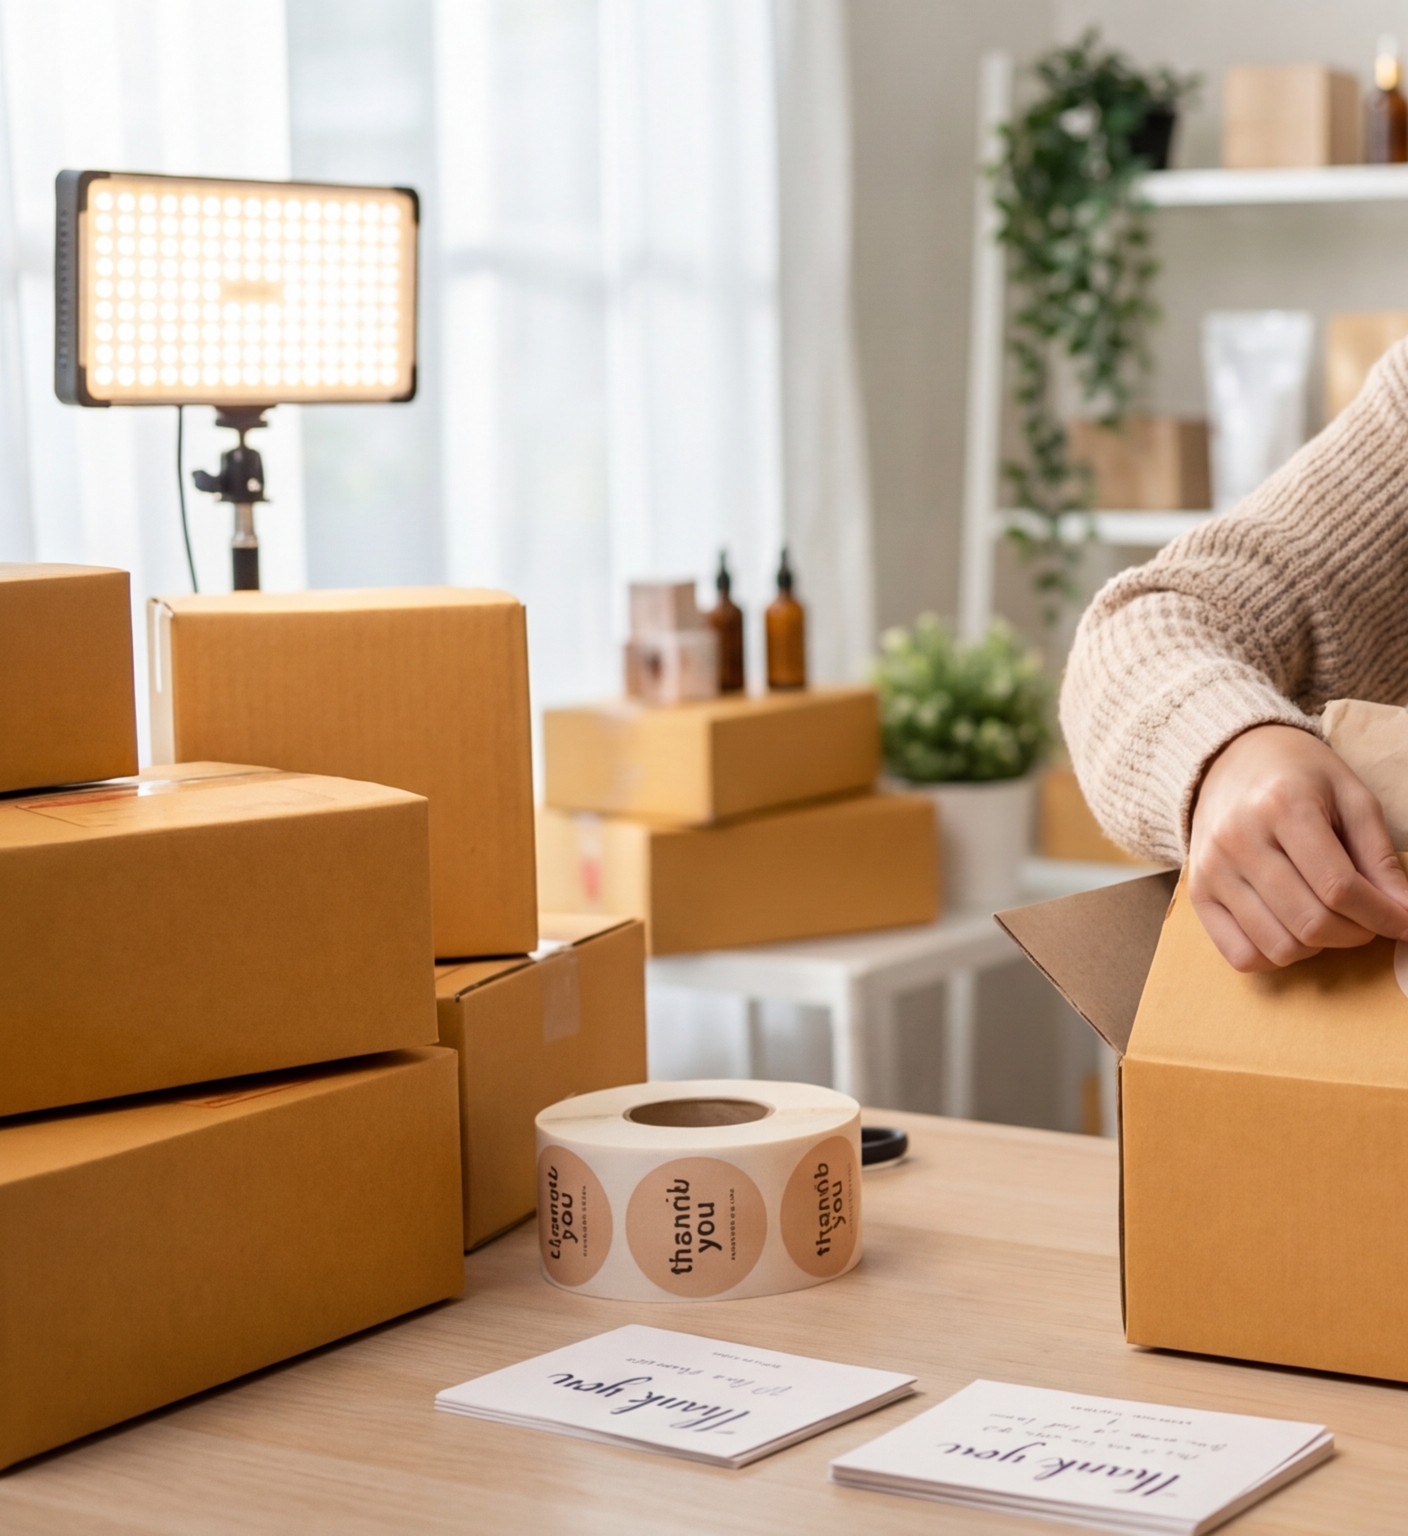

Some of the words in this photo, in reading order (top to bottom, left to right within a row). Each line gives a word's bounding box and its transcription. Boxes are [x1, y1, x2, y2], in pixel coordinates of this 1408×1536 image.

[561, 1192, 579, 1244] you
[832, 1180, 847, 1229] you
[697, 1202, 723, 1253] you
[546, 1372, 653, 1398] you
[610, 1391, 750, 1435] Thank
[936, 1441, 1047, 1465] you
[1032, 1456, 1181, 1499] Thank
